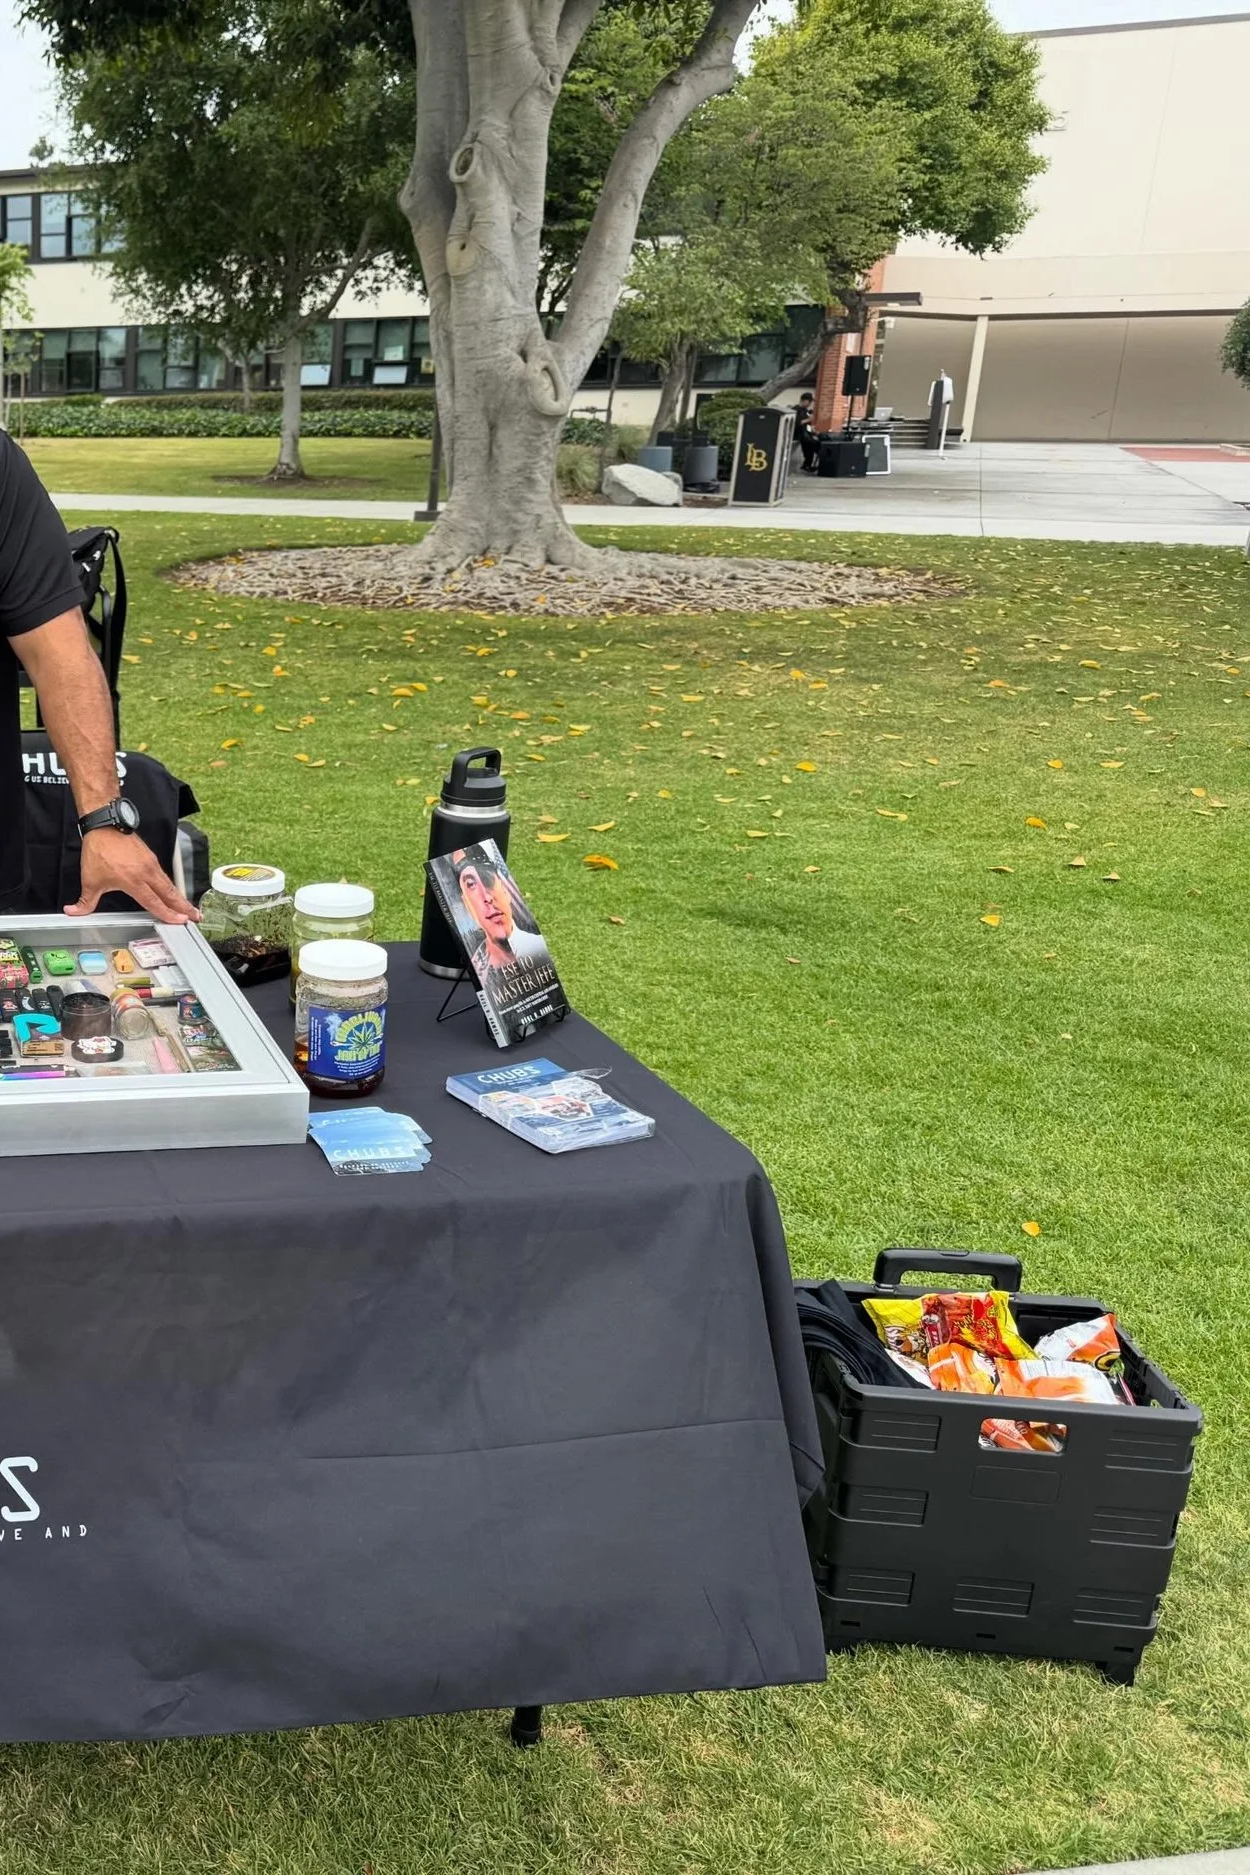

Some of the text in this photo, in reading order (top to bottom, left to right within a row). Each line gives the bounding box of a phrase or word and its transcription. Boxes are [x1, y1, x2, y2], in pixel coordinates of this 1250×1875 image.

[43, 776, 69, 785] BELIE
[502, 955, 534, 981] ESE TO
[492, 972, 538, 1006] MASTER
[535, 963, 555, 988] JEFE
[477, 1064, 542, 1084] CHUBS
[333, 1146, 404, 1160] CHUBS
[45, 1524, 88, 1539] AND
